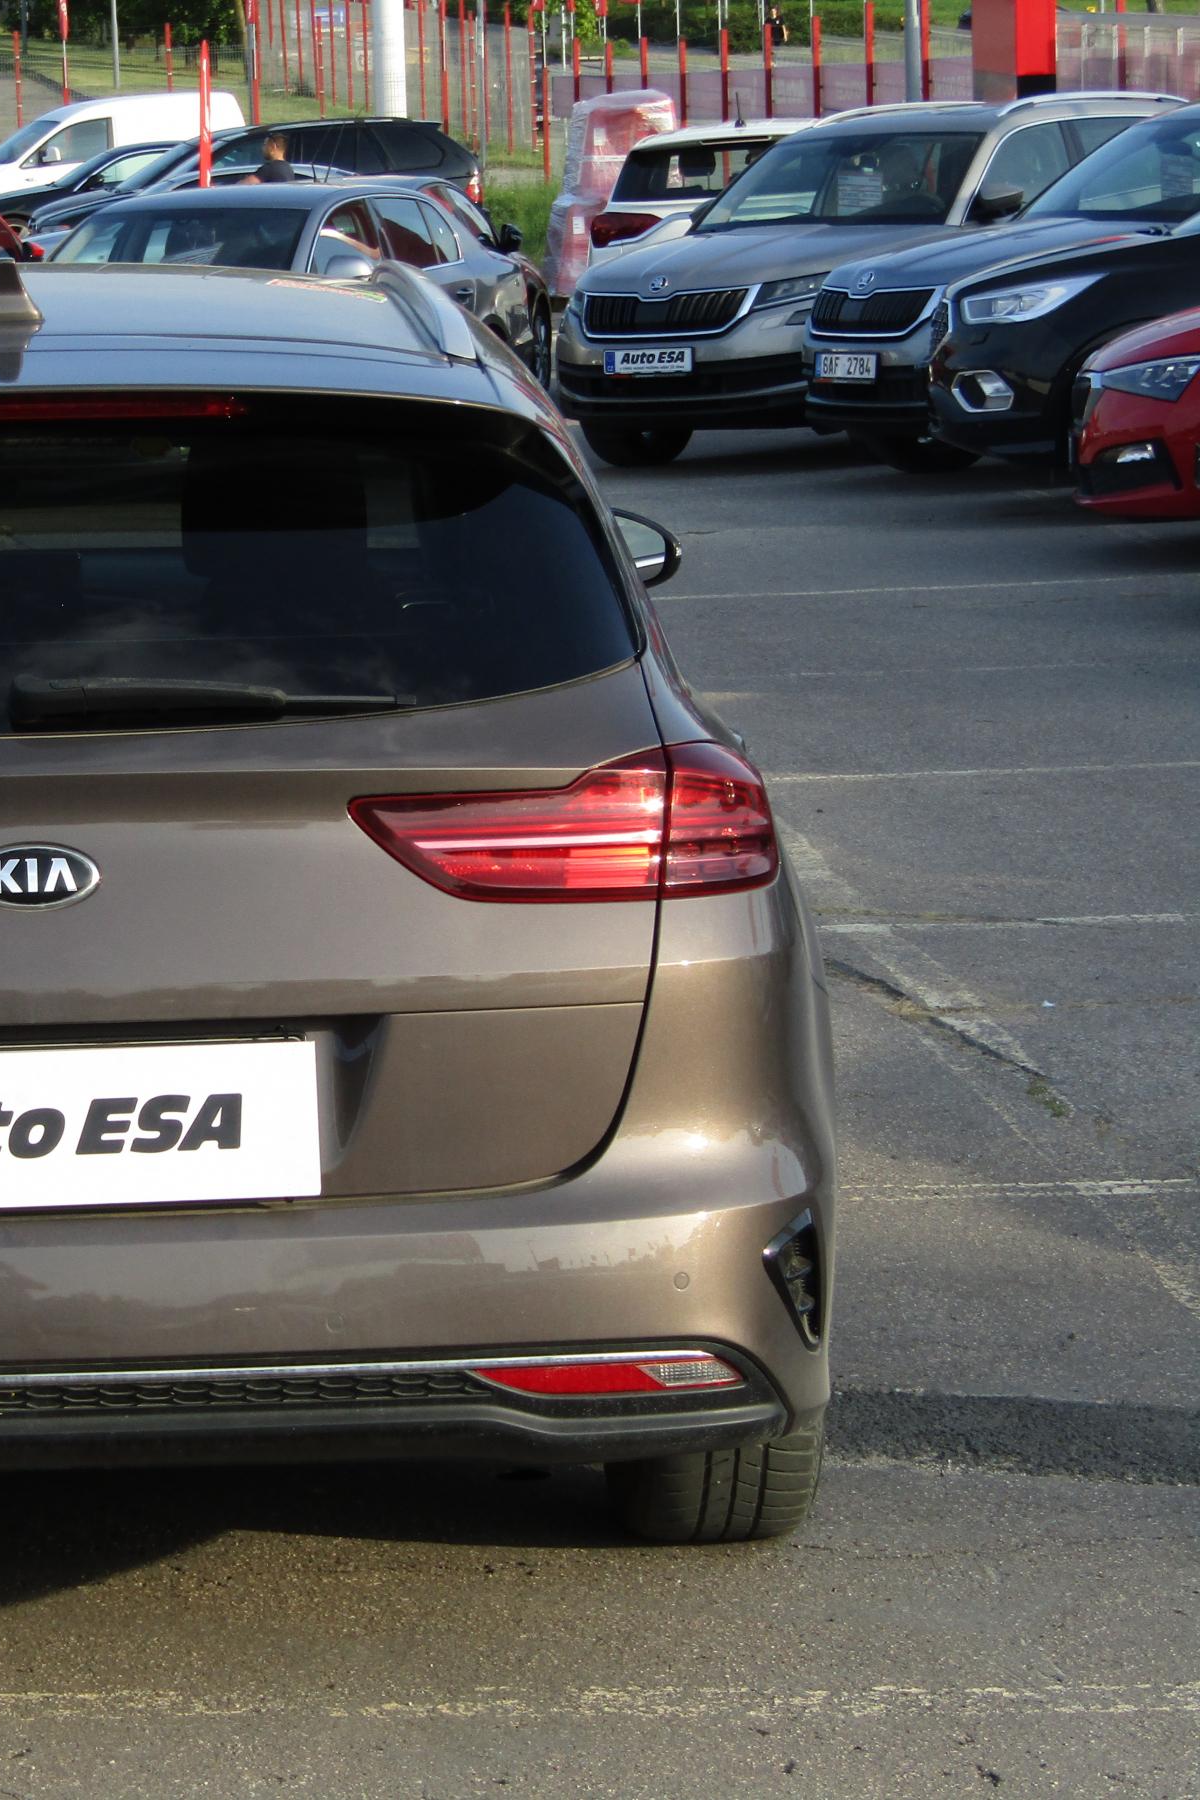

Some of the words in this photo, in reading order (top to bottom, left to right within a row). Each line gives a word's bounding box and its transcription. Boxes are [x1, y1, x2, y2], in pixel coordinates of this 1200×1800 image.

[621, 352, 656, 365] Auto
[657, 351, 685, 364] ESA
[76, 1093, 242, 1155] ESA
